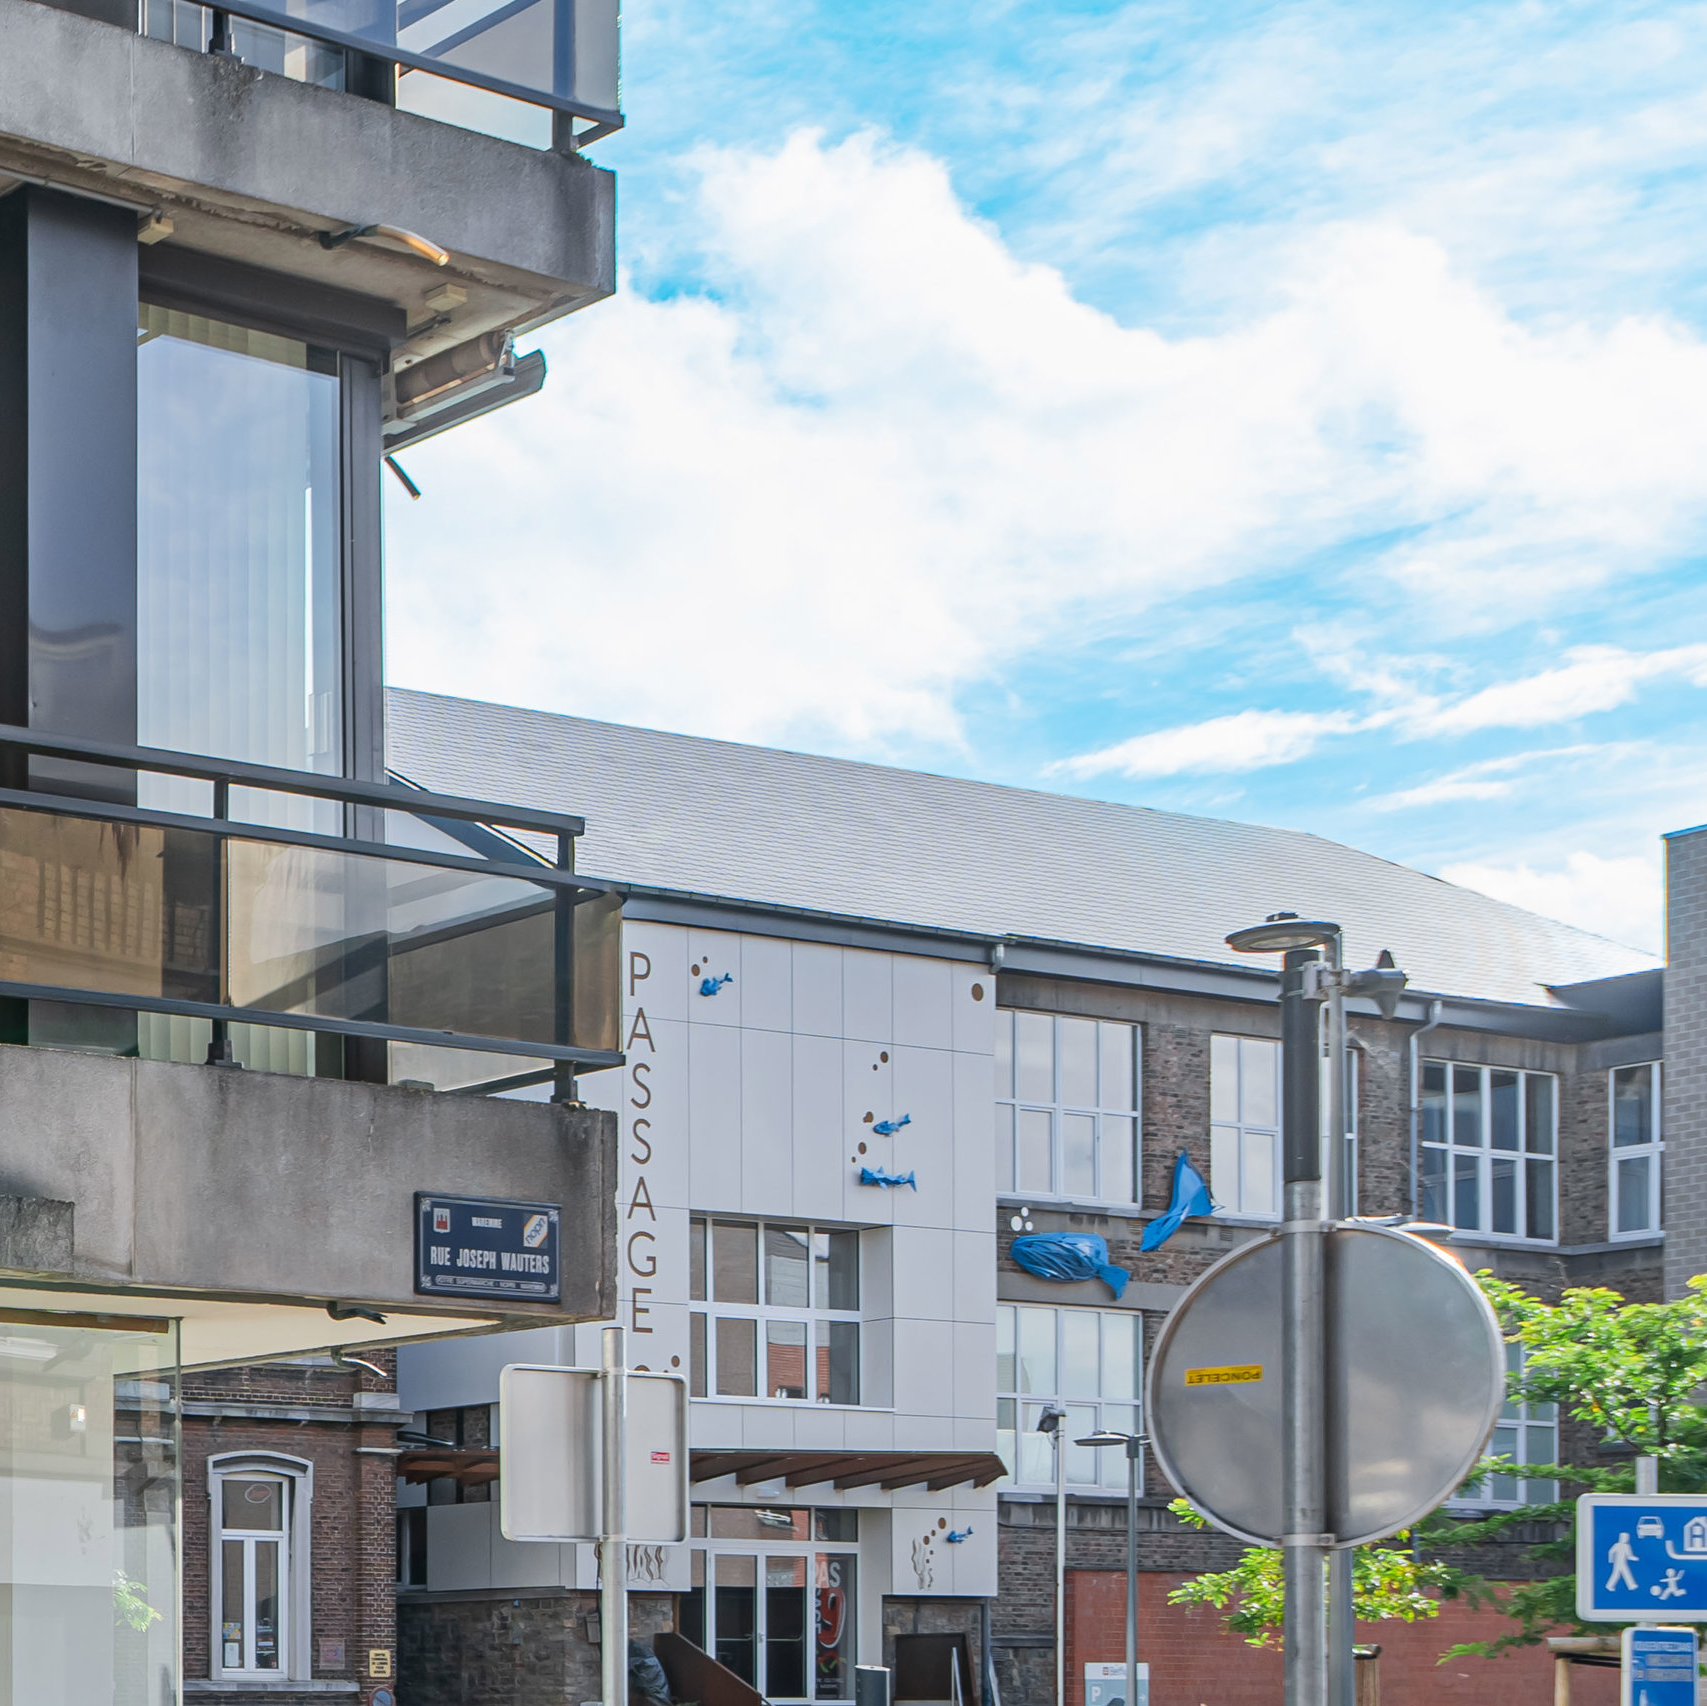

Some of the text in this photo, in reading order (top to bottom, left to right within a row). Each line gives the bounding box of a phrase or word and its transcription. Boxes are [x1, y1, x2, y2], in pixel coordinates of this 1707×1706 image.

[626, 951, 657, 1334] PASSAGE
[430, 1246, 550, 1275] RUE JOSEPH WAUTERS
[1187, 1371, 1260, 1384] PONCELET
